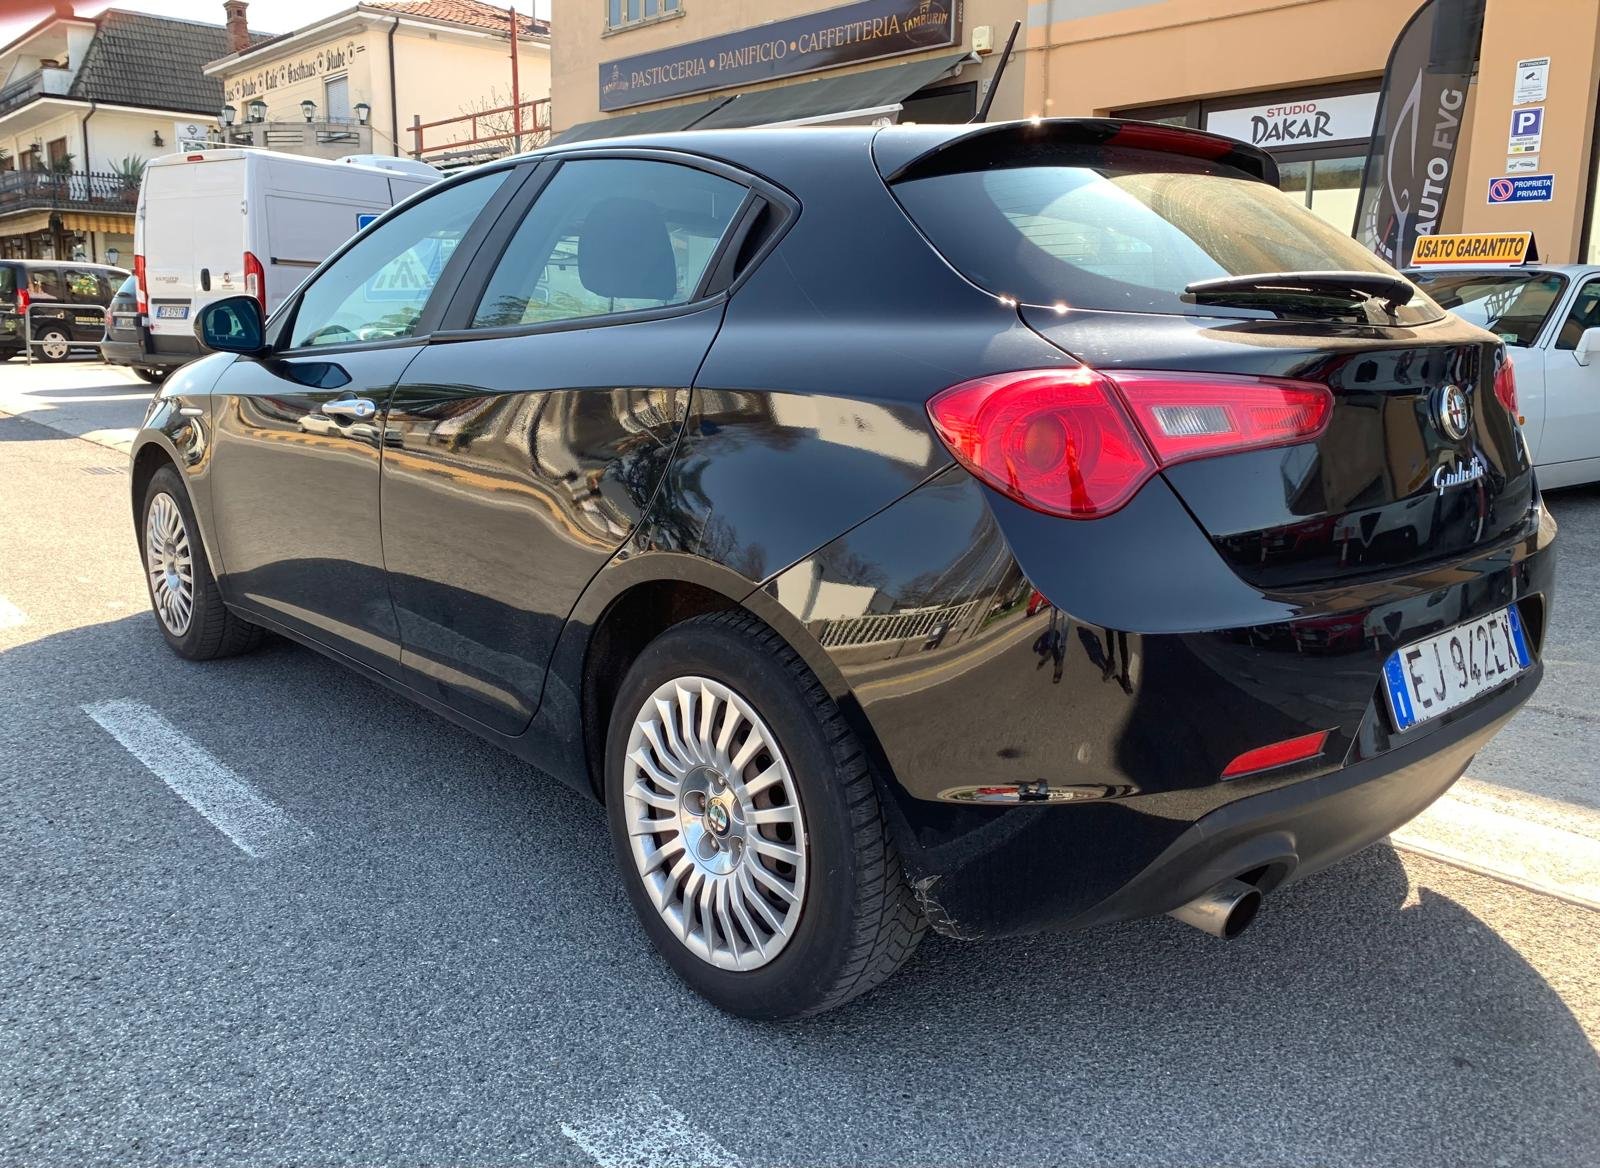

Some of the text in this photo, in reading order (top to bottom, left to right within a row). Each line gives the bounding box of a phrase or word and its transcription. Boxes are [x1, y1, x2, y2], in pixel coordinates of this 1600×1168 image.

[902, 11, 949, 33] TAMBURIN
[631, 14, 901, 89] PASTICCERIA PANIFICIO CAFFETTERIA
[287, 60, 316, 84] Gasthaus
[326, 49, 346, 71] Stube
[1266, 103, 1317, 118] STUDIO
[1251, 111, 1334, 145] DAKAR
[1414, 87, 1463, 236] AUTO FVG
[1517, 189, 1546, 198] PRIVATA
[1417, 237, 1524, 258] USATO GARANTITO
